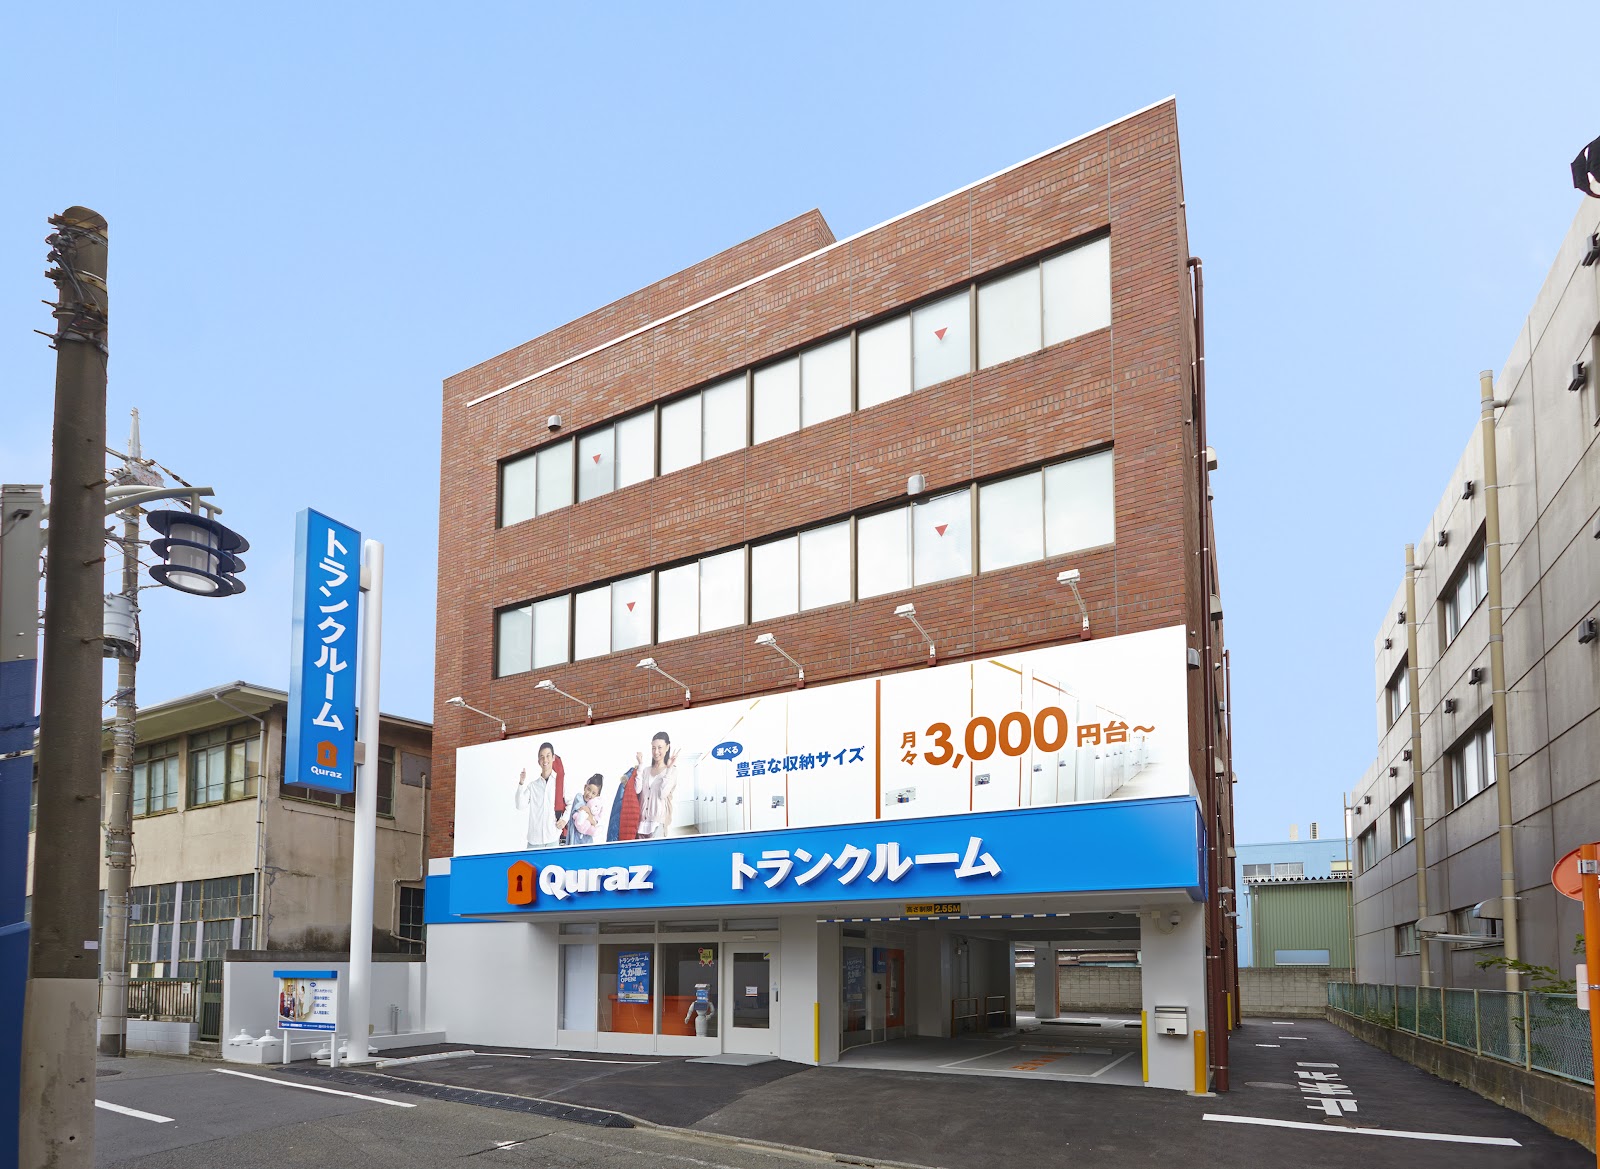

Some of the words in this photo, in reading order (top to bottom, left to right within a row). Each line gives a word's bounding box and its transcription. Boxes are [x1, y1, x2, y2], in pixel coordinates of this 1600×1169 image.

[313, 528, 349, 731] トランクルーム
[716, 746, 739, 756] 選べる
[736, 746, 865, 779] 豊富な収納サイズ
[311, 766, 342, 779] Quraz
[731, 836, 1002, 890] トランクルーム
[539, 864, 654, 901] Quraz
